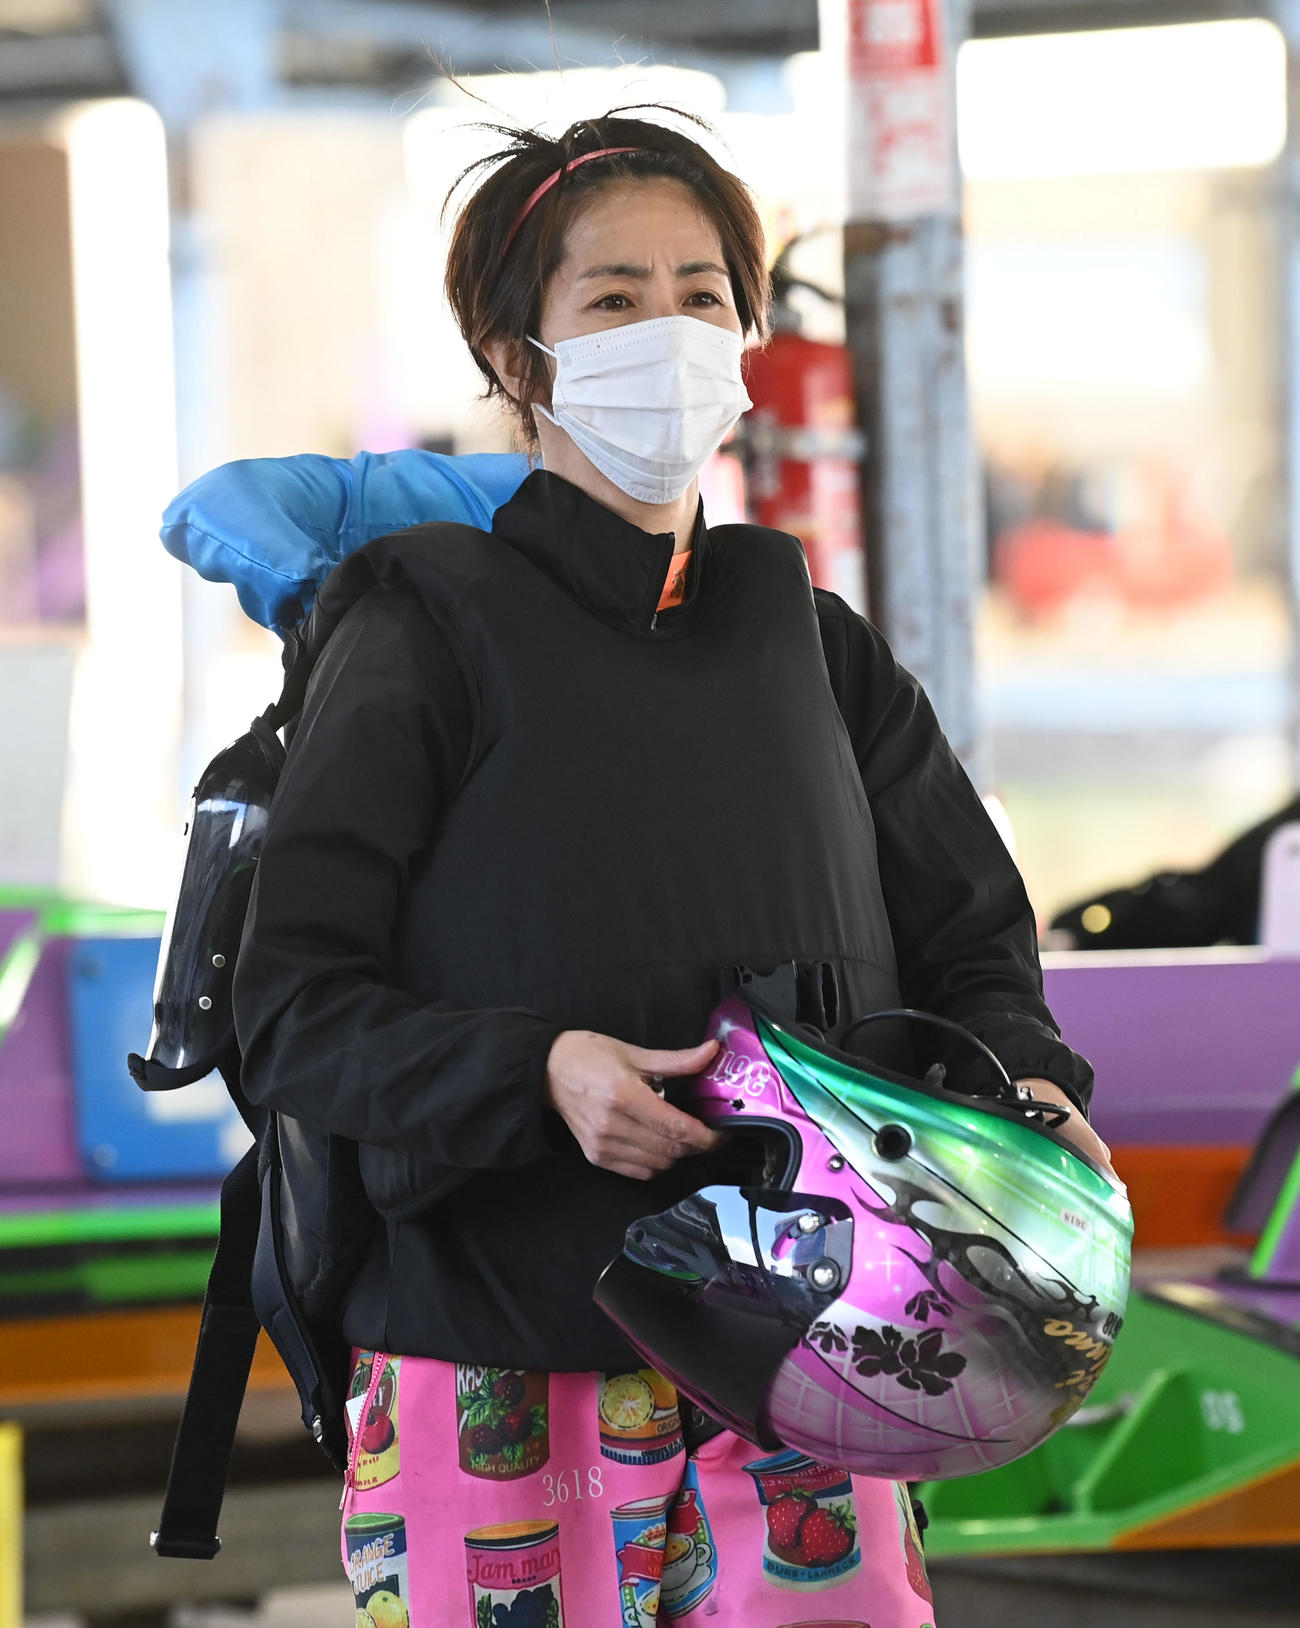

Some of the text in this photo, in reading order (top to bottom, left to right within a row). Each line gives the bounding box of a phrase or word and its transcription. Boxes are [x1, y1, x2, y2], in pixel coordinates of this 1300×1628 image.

[706, 1048, 771, 1097] 361
[471, 1456, 541, 1473] HIGH QUALITY
[542, 1466, 604, 1507] 3618
[350, 1533, 395, 1574] ORANGE
[467, 1554, 516, 1583] Jam
[353, 1562, 386, 1595] JUICE
